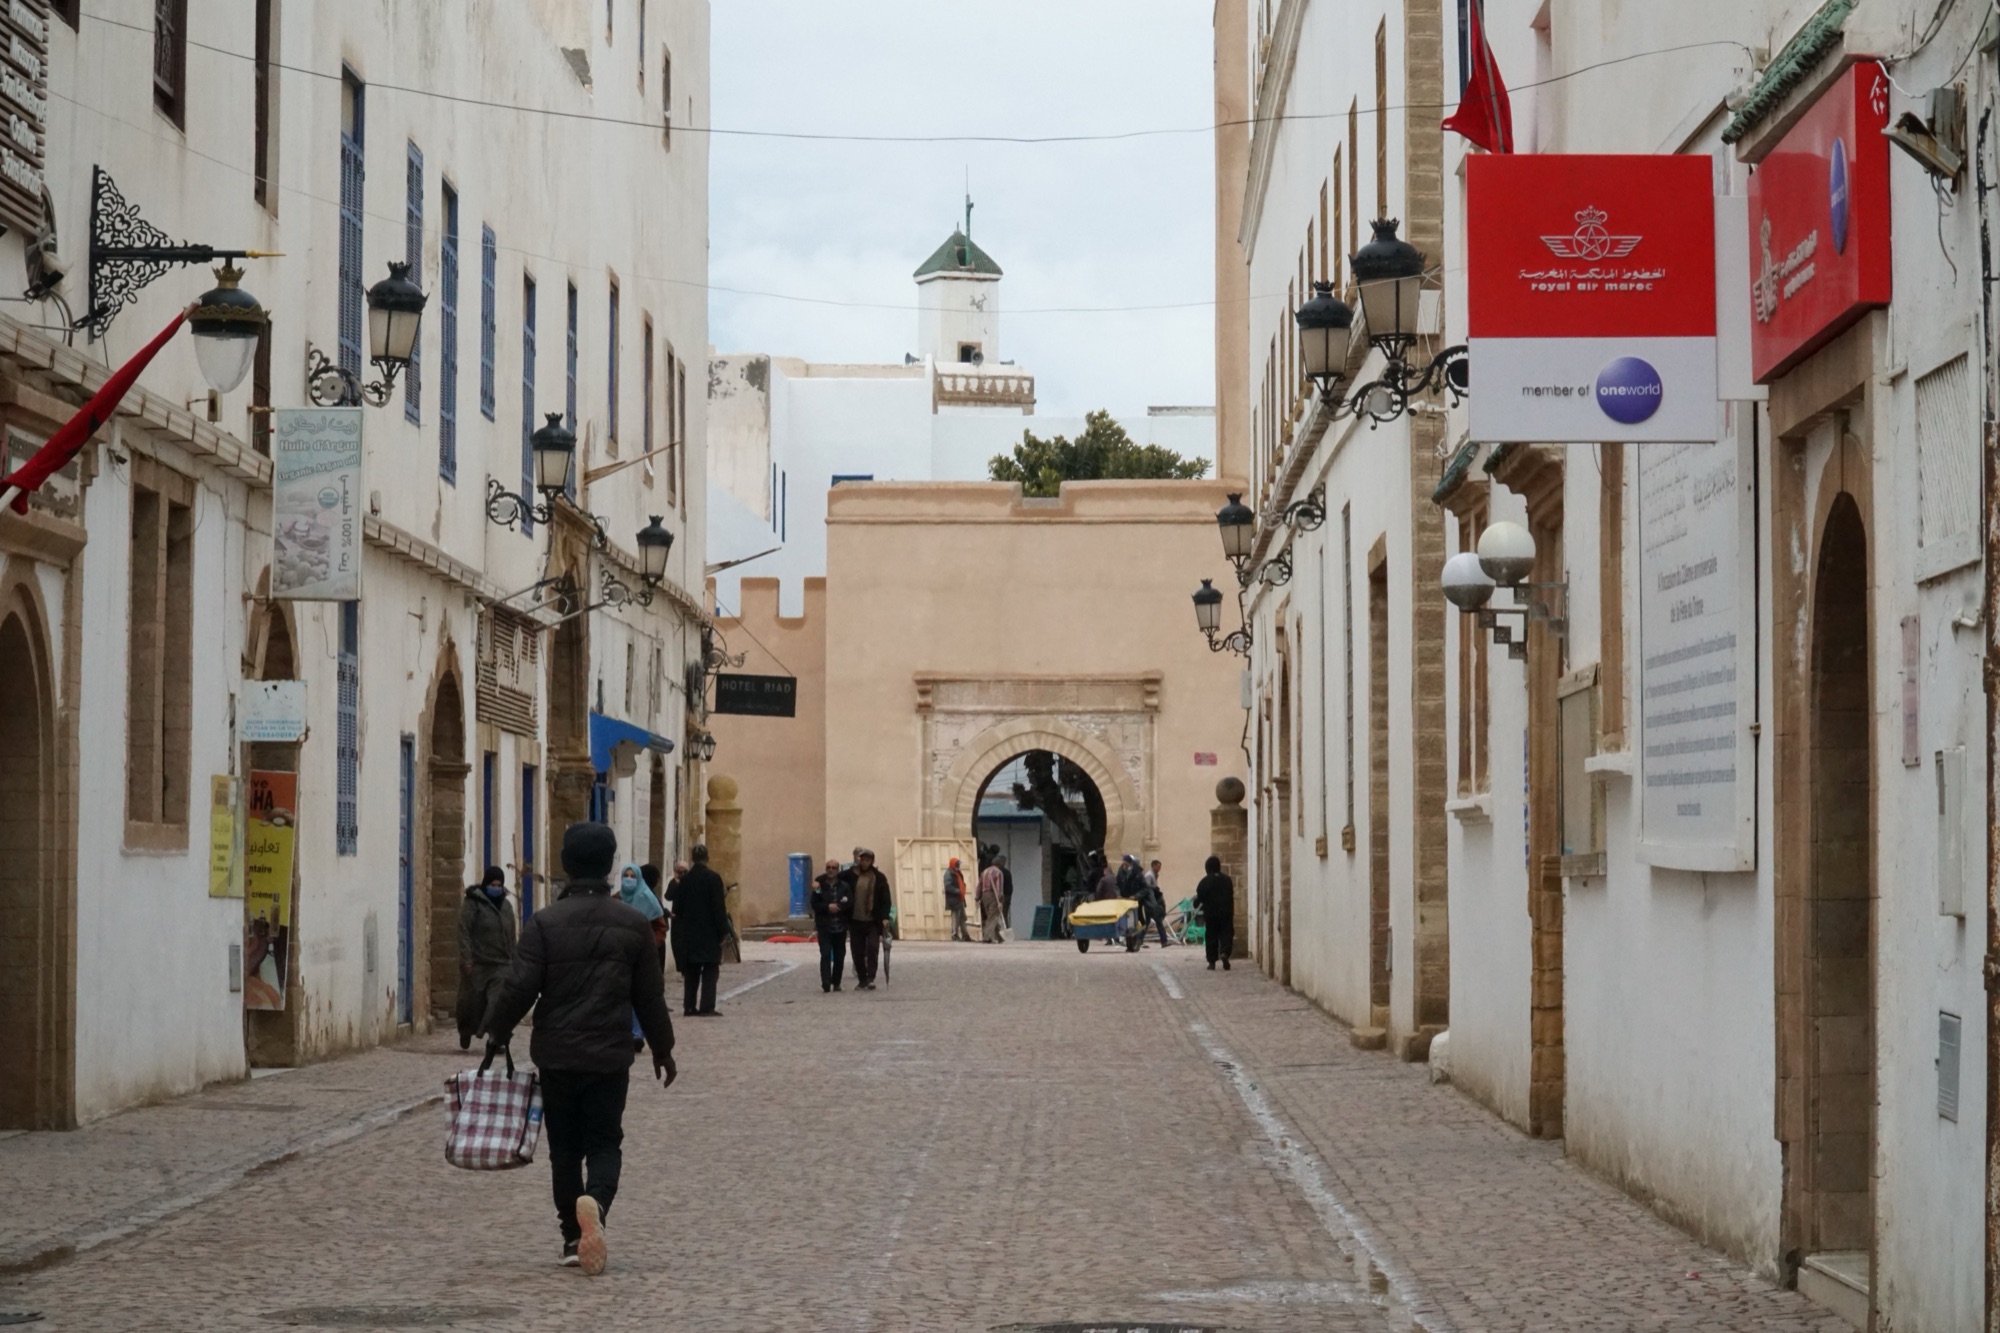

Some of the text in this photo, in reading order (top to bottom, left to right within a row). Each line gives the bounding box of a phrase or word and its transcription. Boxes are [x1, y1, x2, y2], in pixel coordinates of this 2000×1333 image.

[1518, 268, 1666, 280] الخطوط الملكية المغربية
[1531, 281, 1653, 292] royal air maroc
[1522, 383, 1660, 397] member of oneworld
[280, 440, 358, 454] Huile d'Argan
[278, 454, 358, 481] Organic Argan oil
[341, 517, 352, 548] 100%
[721, 680, 791, 693] HOTEL RIAD
[250, 789, 273, 810] HA
